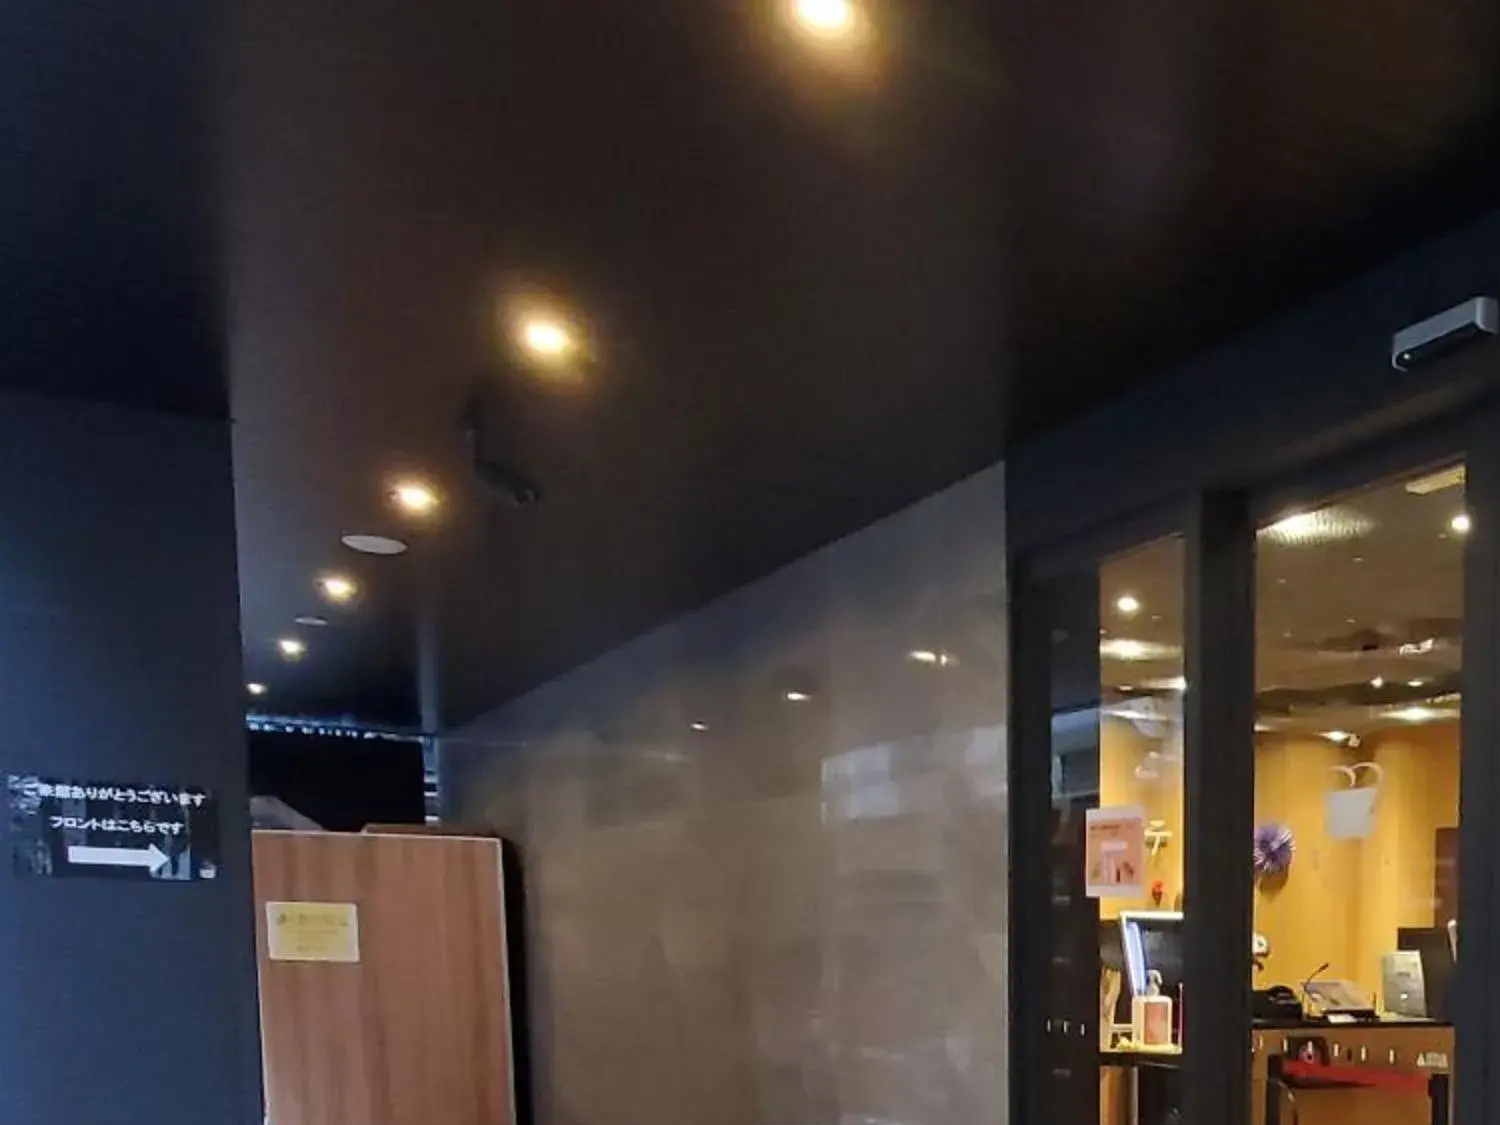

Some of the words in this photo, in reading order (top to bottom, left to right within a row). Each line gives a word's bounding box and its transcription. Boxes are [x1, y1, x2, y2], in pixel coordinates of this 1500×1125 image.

[50, 816, 184, 834] フロントはこちらです
